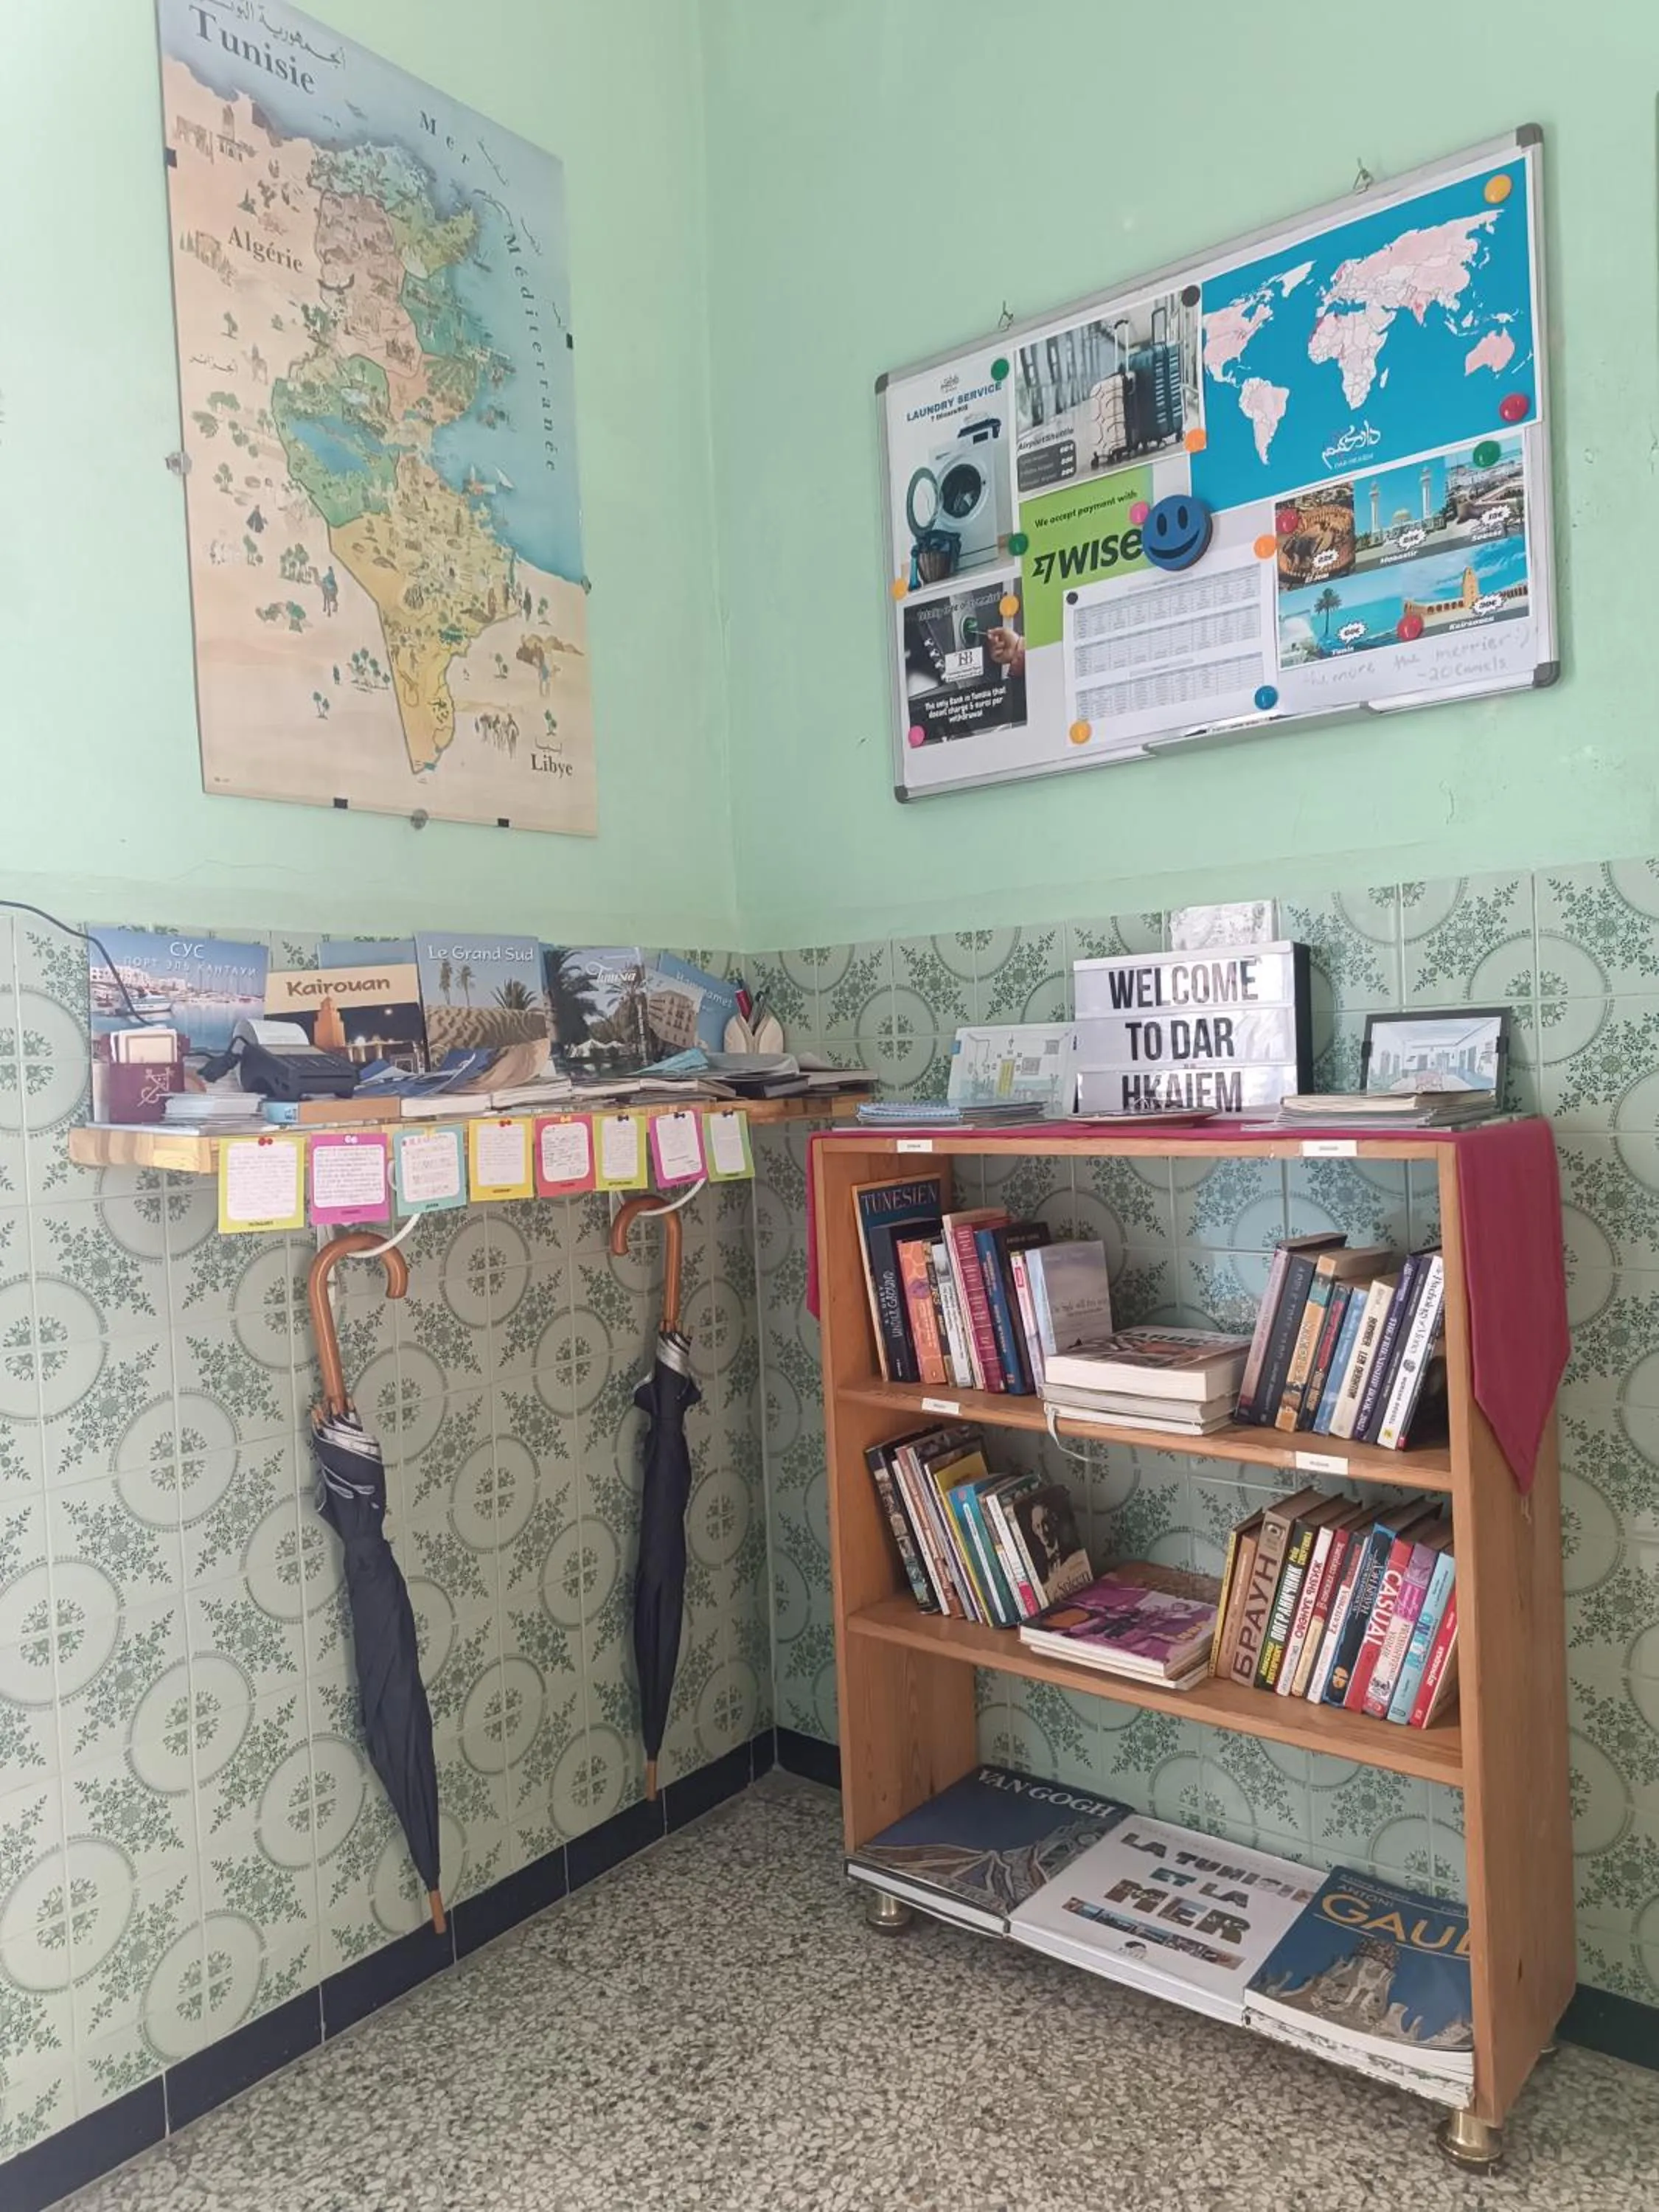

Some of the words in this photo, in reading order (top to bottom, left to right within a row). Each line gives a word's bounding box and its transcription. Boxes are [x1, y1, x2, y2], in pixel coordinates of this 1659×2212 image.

[189, 6, 316, 95] Tunisie
[228, 226, 304, 275] Algérie
[906, 396, 955, 421] LAUNDRY
[957, 381, 1002, 403] SERVICE
[1034, 517, 1048, 528] We
[1050, 509, 1077, 524] accept
[1077, 497, 1116, 517] payment
[1117, 490, 1138, 504] with
[531, 753, 574, 779] Libye
[428, 945, 448, 959] Le
[451, 945, 502, 961] Grand
[506, 945, 535, 961] Sud
[285, 977, 391, 997] Kairouan
[1107, 956, 1259, 1010] WELCOME
[1125, 1020, 1162, 1062] TO
[1170, 1016, 1237, 1059] DAR
[860, 1183, 939, 1216] TUNESIEN
[1361, 1316, 1378, 1346] BOMBER
[1357, 1351, 1368, 1366] LEN
[1306, 1561, 1324, 1596] ЖИЗНЬ
[1232, 1551, 1277, 1680] БРАУН
[1270, 1563, 1303, 1641] ПОГРАНИЧНИК
[1364, 1568, 1402, 1646] CASUAL
[978, 1770, 1025, 1795] VAN
[1027, 1784, 1118, 1819] GOGH
[1120, 1832, 1169, 1859] LA
[1149, 1866, 1198, 1888] ET
[1198, 1881, 1250, 1909] LA
[1336, 1884, 1394, 1907] ANTONI
[1104, 1878, 1251, 1945] MER
